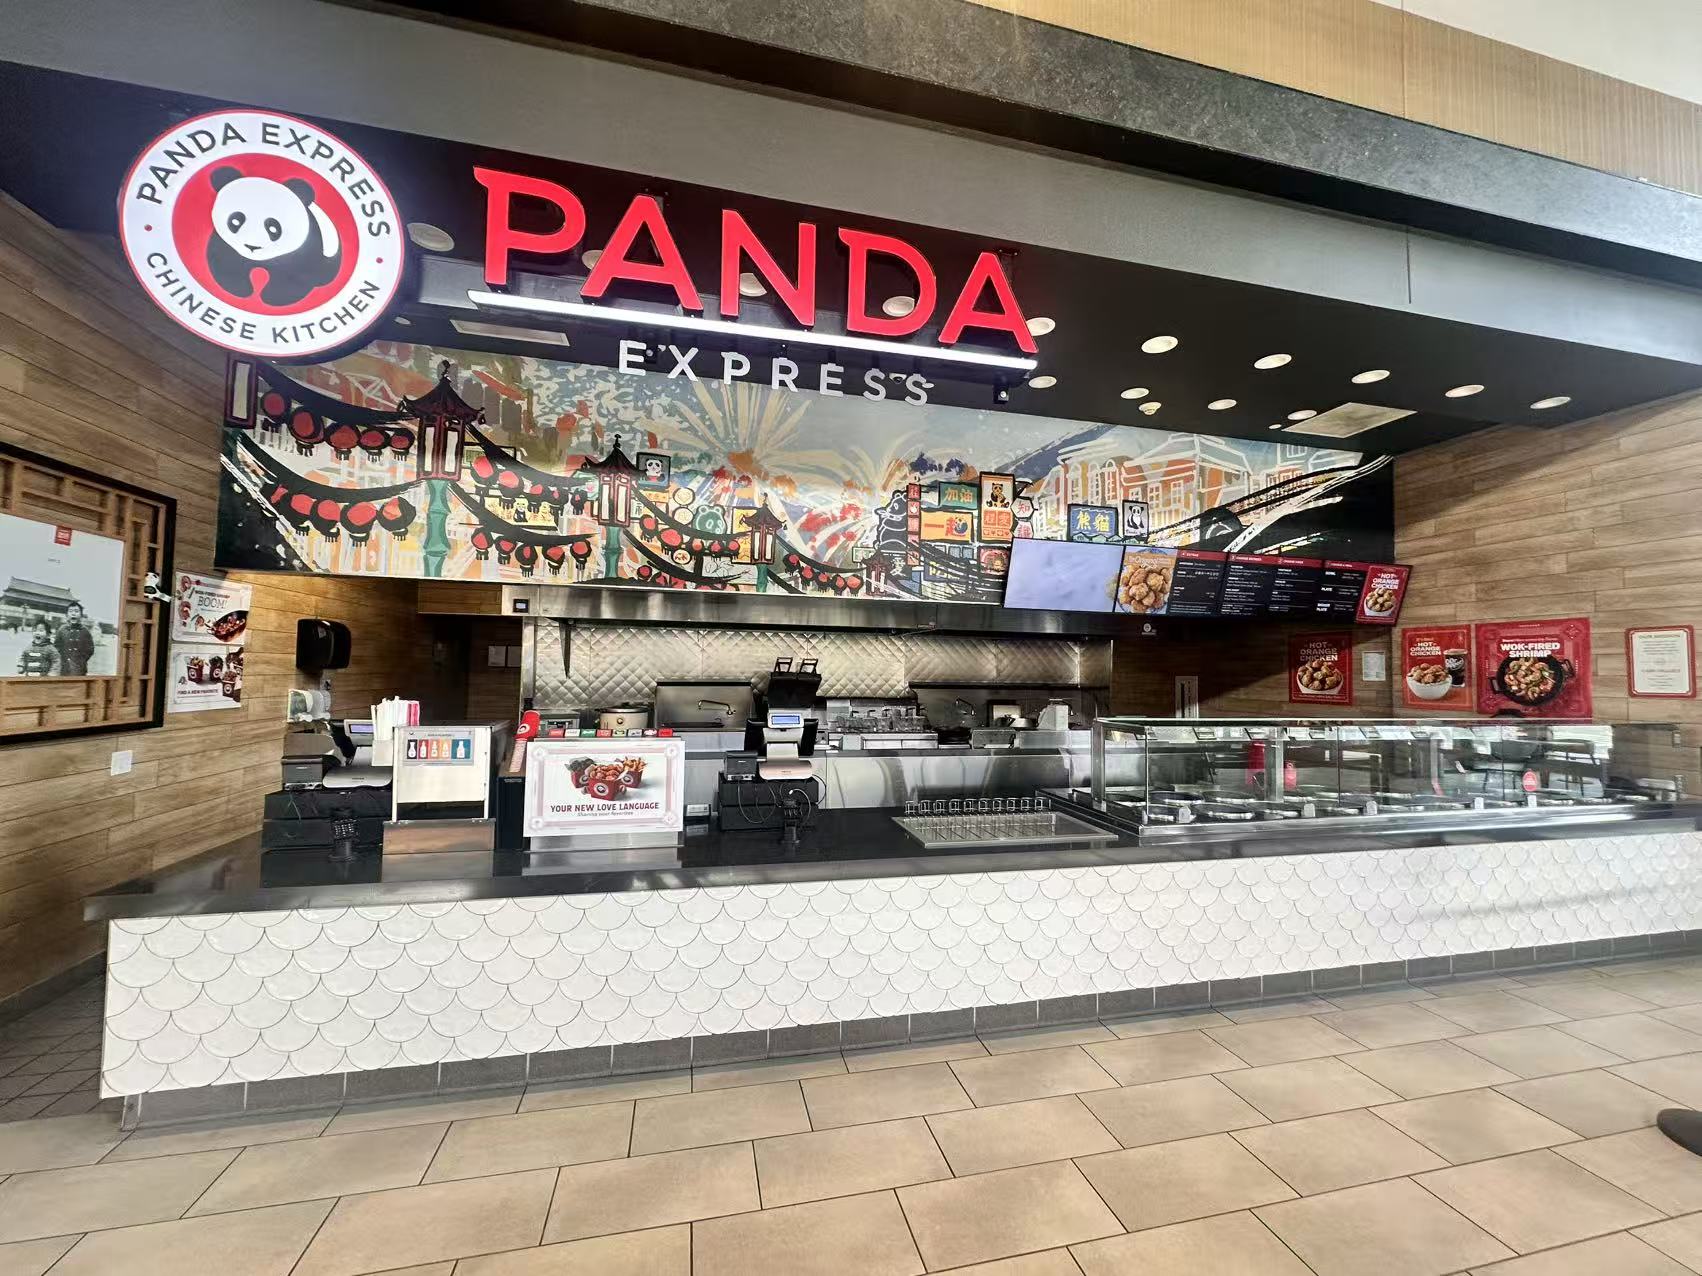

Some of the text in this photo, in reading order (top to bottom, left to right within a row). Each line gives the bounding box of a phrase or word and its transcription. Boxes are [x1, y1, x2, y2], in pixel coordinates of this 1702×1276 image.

[136, 122, 391, 238] PANDA EXPRESS
[473, 166, 1039, 354] PANDA
[146, 252, 381, 344] CHINESE KITCHEN
[619, 339, 930, 407] EXPRESS
[1500, 642, 1561, 651] WOK-FIRED
[1509, 649, 1552, 658] SHRIMP
[550, 802, 660, 813] YOUR NEW LOVE LANGUAGE
